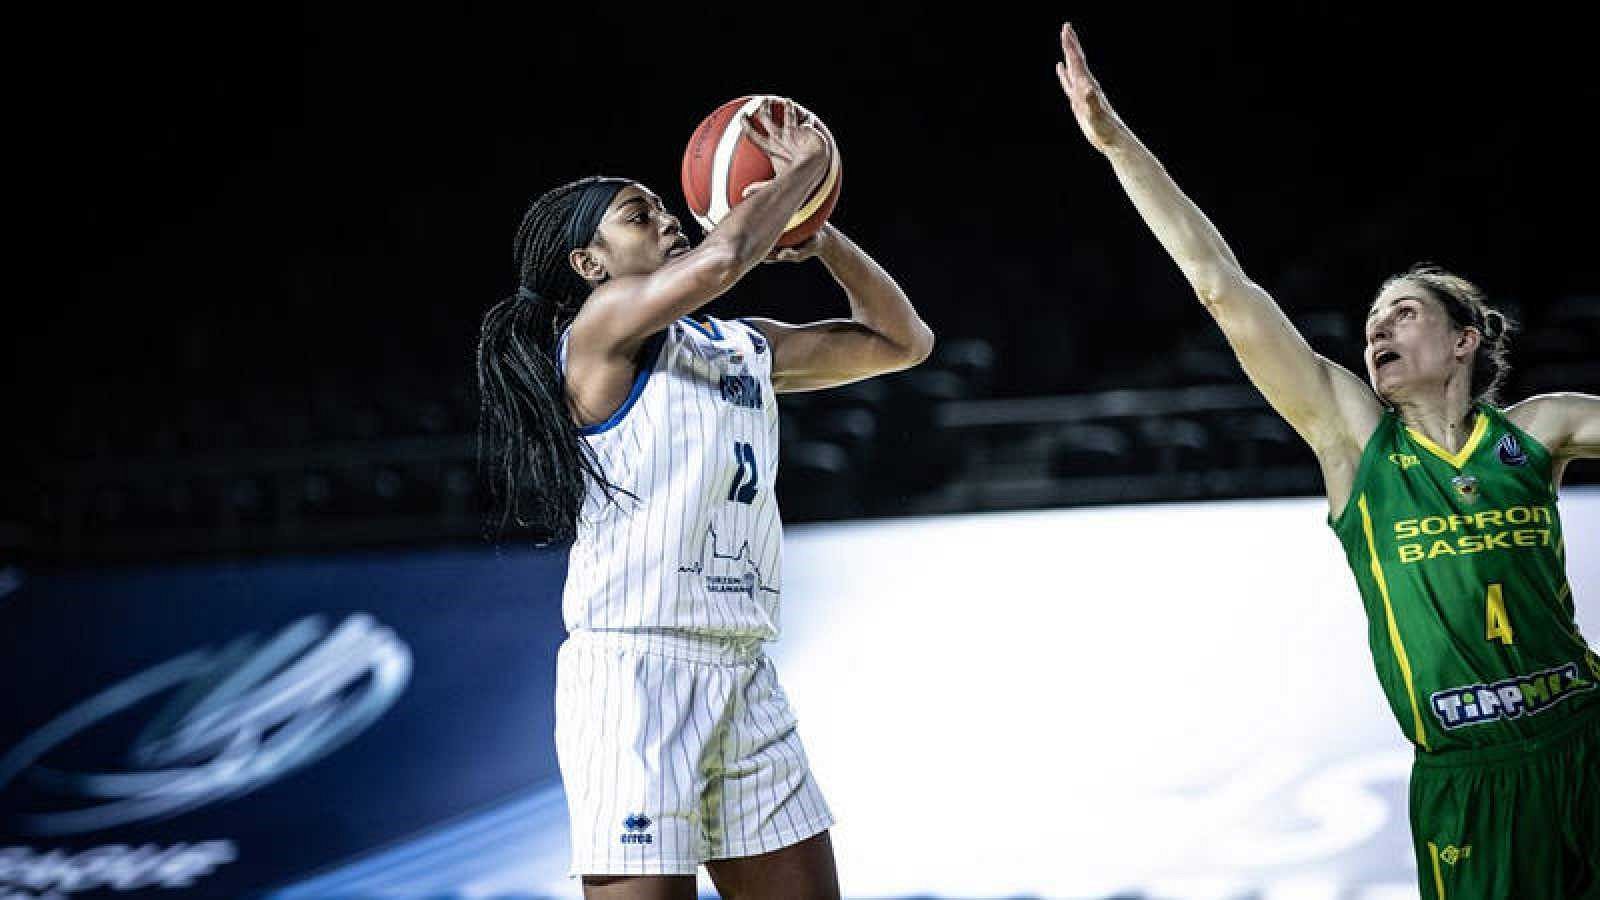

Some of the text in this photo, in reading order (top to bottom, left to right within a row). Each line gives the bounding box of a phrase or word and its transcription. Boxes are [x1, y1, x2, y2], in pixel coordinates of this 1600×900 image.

[727, 441, 758, 504] 12
[1394, 506, 1550, 540] SOPRON
[1398, 529, 1549, 564] BASKET
[1486, 584, 1513, 644] 4
